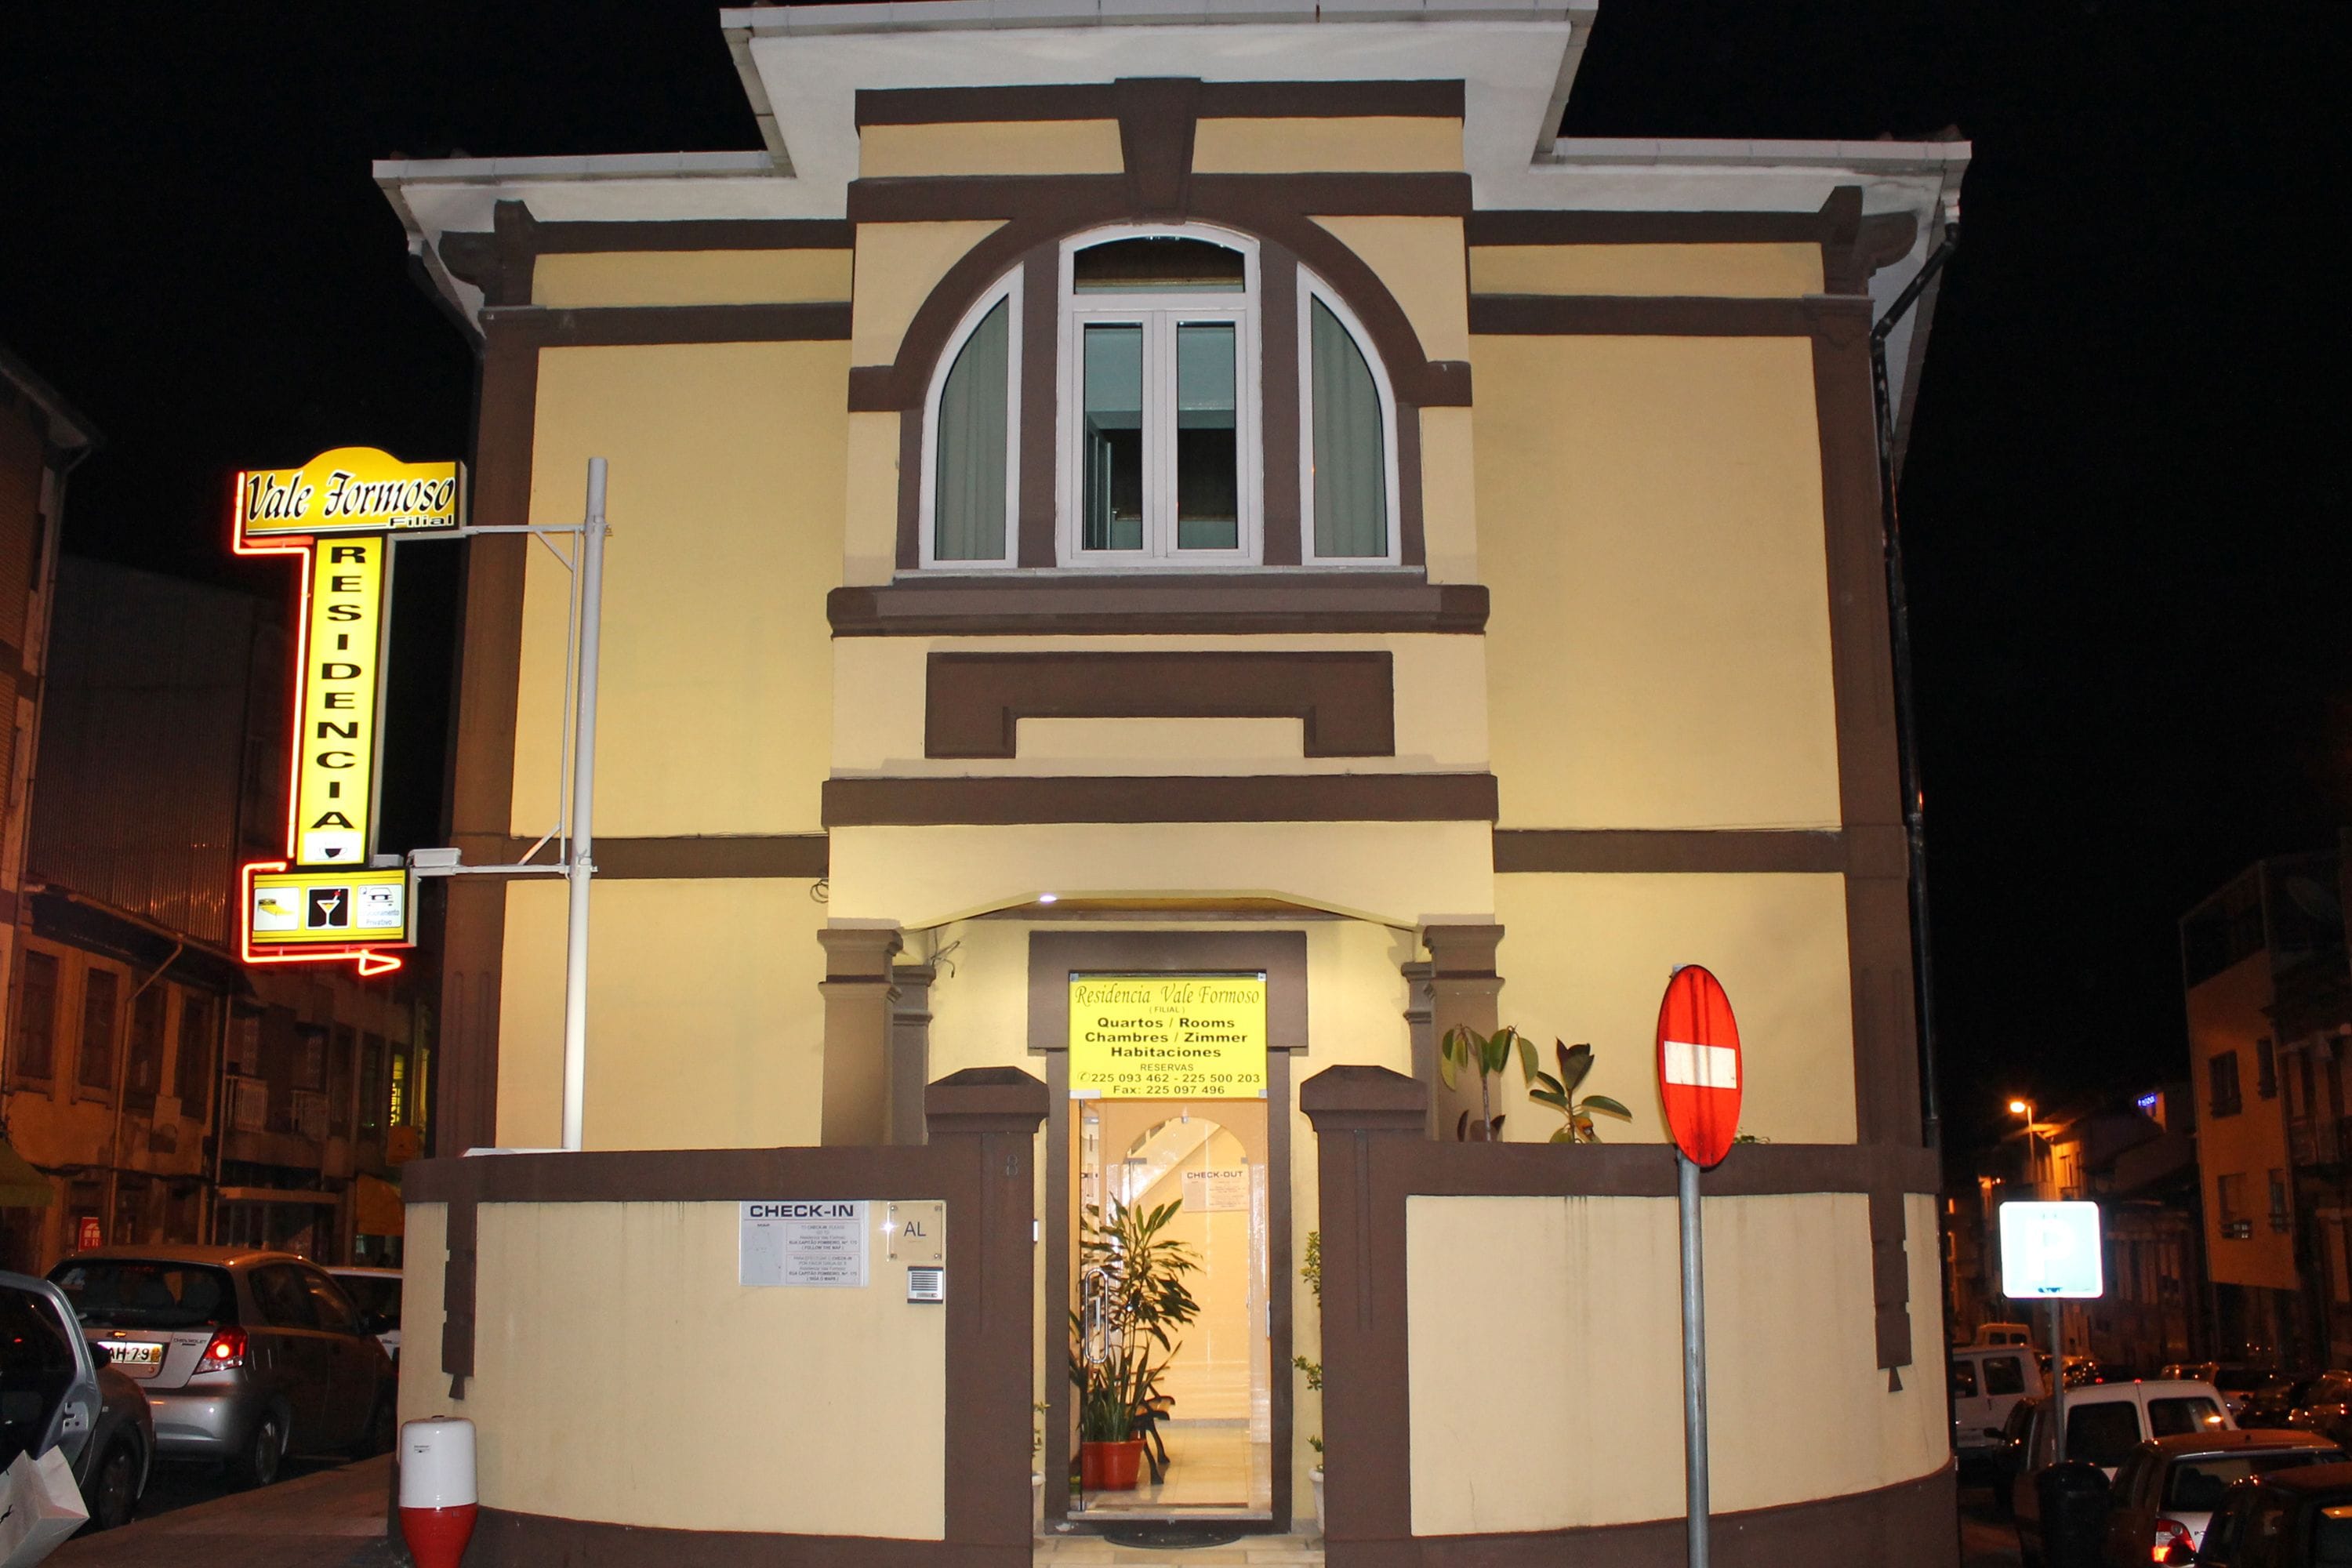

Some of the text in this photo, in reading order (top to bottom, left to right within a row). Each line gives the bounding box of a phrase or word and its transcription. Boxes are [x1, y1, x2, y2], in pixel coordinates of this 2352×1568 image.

[248, 472, 455, 521] Vale Formoso
[390, 514, 453, 527] Filial
[310, 546, 366, 829] RESIDENCIA
[1075, 982, 1260, 1007] Residencia Vale Formoso
[1098, 1017, 1163, 1029] Quartos
[1179, 1017, 1236, 1029] Rooms
[1085, 1032, 1168, 1043] Chambres
[1184, 1032, 1248, 1043] Zimmer
[1111, 1047, 1221, 1058] Habitaciones
[1141, 1063, 1194, 1072] RESERVAS
[1091, 1074, 1115, 1083] 225
[1119, 1074, 1142, 1083] 093
[1146, 1074, 1169, 1083] 462
[1182, 1074, 1206, 1083] 225
[1210, 1074, 1233, 1083] 500
[1237, 1074, 1261, 1083] 203
[1113, 1085, 1225, 1094] Fax: 225 097 496
[1187, 1171, 1243, 1179] CHECK-OUT
[750, 1204, 855, 1218] CHECK-IN
[903, 1221, 927, 1237] AL
